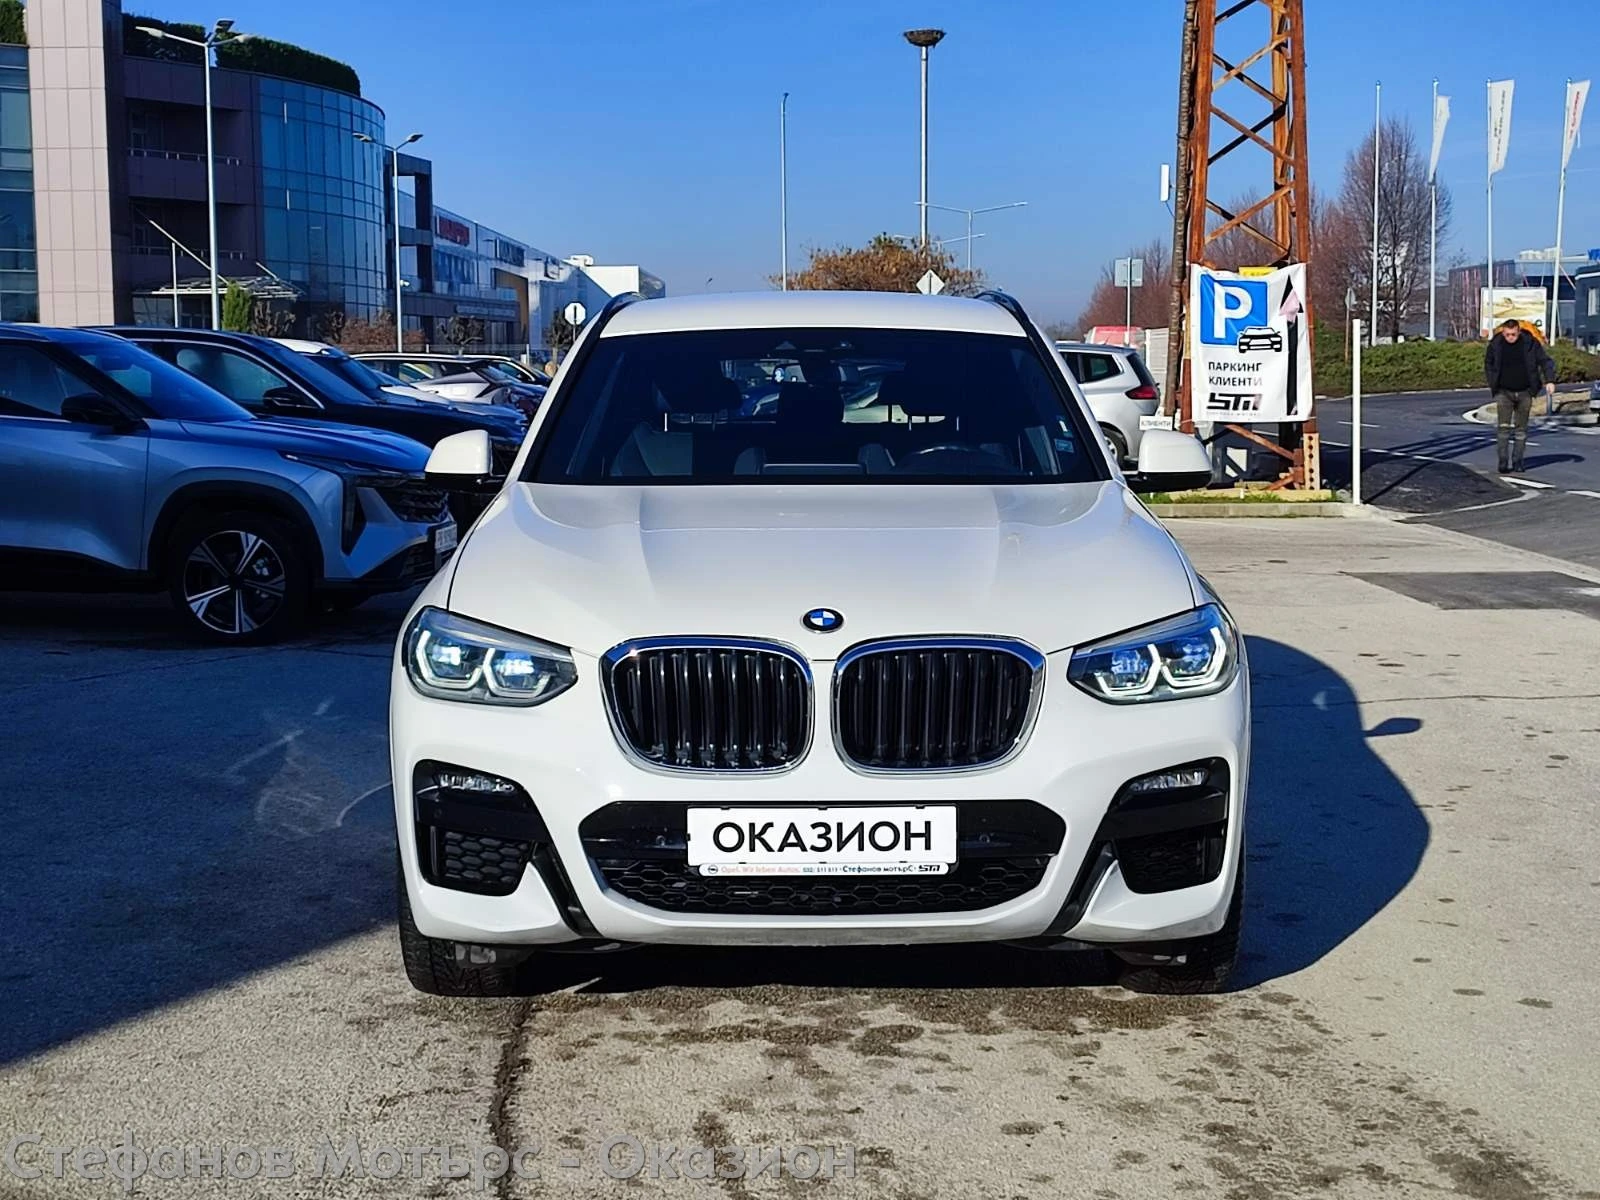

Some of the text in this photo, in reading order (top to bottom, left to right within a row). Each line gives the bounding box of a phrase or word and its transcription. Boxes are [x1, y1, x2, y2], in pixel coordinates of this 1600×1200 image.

[1213, 282, 1252, 338] P
[1208, 361, 1262, 372] ПАРКИНГ
[1208, 376, 1262, 387] КЛИЕНТИ
[713, 821, 932, 852] ОКАЗИОН
[842, 865, 882, 874] Стефанов
